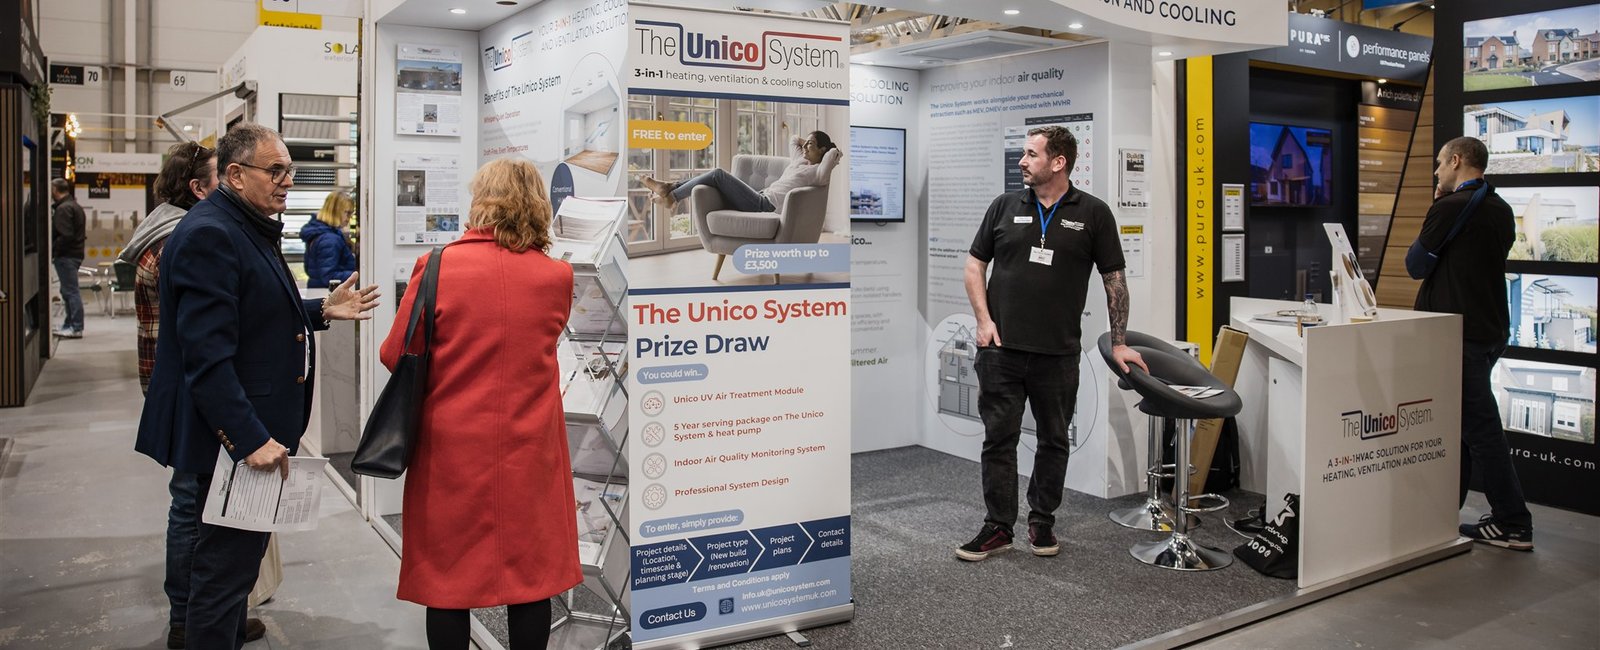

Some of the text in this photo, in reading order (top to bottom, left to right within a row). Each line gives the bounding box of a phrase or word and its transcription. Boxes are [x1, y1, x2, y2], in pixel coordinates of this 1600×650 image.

[1124, 0, 1236, 26] AND COOLING
[555, 25, 594, 47] VENTILATION
[596, 12, 628, 33] SOLUTIO
[635, 28, 676, 57] The
[687, 32, 759, 63] Unico
[1362, 42, 1430, 63] performance panels
[494, 47, 511, 66] Unico
[88, 71, 98, 82] 70
[174, 76, 185, 87] 69
[634, 69, 842, 90] 3-in-1 heating, ventilation & cooling solution
[930, 68, 1064, 92] Improving your indoor air quality
[484, 89, 504, 104] Benefits
[511, 86, 520, 96] The
[521, 80, 538, 94] Unico
[539, 75, 561, 92] System
[954, 99, 972, 108] System
[990, 95, 1016, 105] alongside
[1031, 90, 1064, 100] mechanical
[1009, 102, 1037, 111] combined
[1052, 99, 1071, 107] MVHR
[632, 130, 707, 141] FREE to enter
[1193, 117, 1208, 299] www.pura-uk.com
[744, 247, 829, 260] Prize worth up to
[744, 260, 778, 270] £3,500
[633, 299, 847, 325] The Unico System
[636, 334, 770, 358] Prize Draw
[877, 357, 888, 365] Air
[643, 371, 659, 380] You
[660, 369, 683, 380] could
[673, 386, 804, 404] Unico UV Air Treatment Module
[674, 410, 824, 431] 5 Year serving package on The Unico
[1342, 418, 1360, 438] The
[1364, 413, 1396, 434] Unico
[674, 426, 762, 443] System & heat pump
[674, 444, 826, 467] Indoor Air Quality Monitoring System
[1328, 459, 1333, 468] A
[1376, 444, 1410, 459] SOLUTION
[1411, 441, 1424, 453] FOR
[1425, 438, 1442, 449] YOUR
[1323, 449, 1446, 483] HEATING, VENTILATION AND COOLING
[675, 476, 789, 497] Professional System Design
[645, 514, 738, 533] To enter, simply provide:
[770, 535, 795, 545] Project
[818, 528, 845, 538] Contact
[636, 544, 687, 559] Project details
[707, 539, 749, 551] Project type
[773, 547, 792, 556] plans
[821, 539, 844, 548] details
[642, 555, 678, 566] (Location,
[710, 549, 747, 561] (New build
[640, 563, 675, 574] timescale
[707, 559, 750, 571] /renovation)
[635, 570, 689, 585] planning stage)
[692, 572, 790, 593] Terms and Conditions apply
[741, 589, 837, 612] www.unicosystemuk.com
[647, 609, 696, 624] Contact Us
